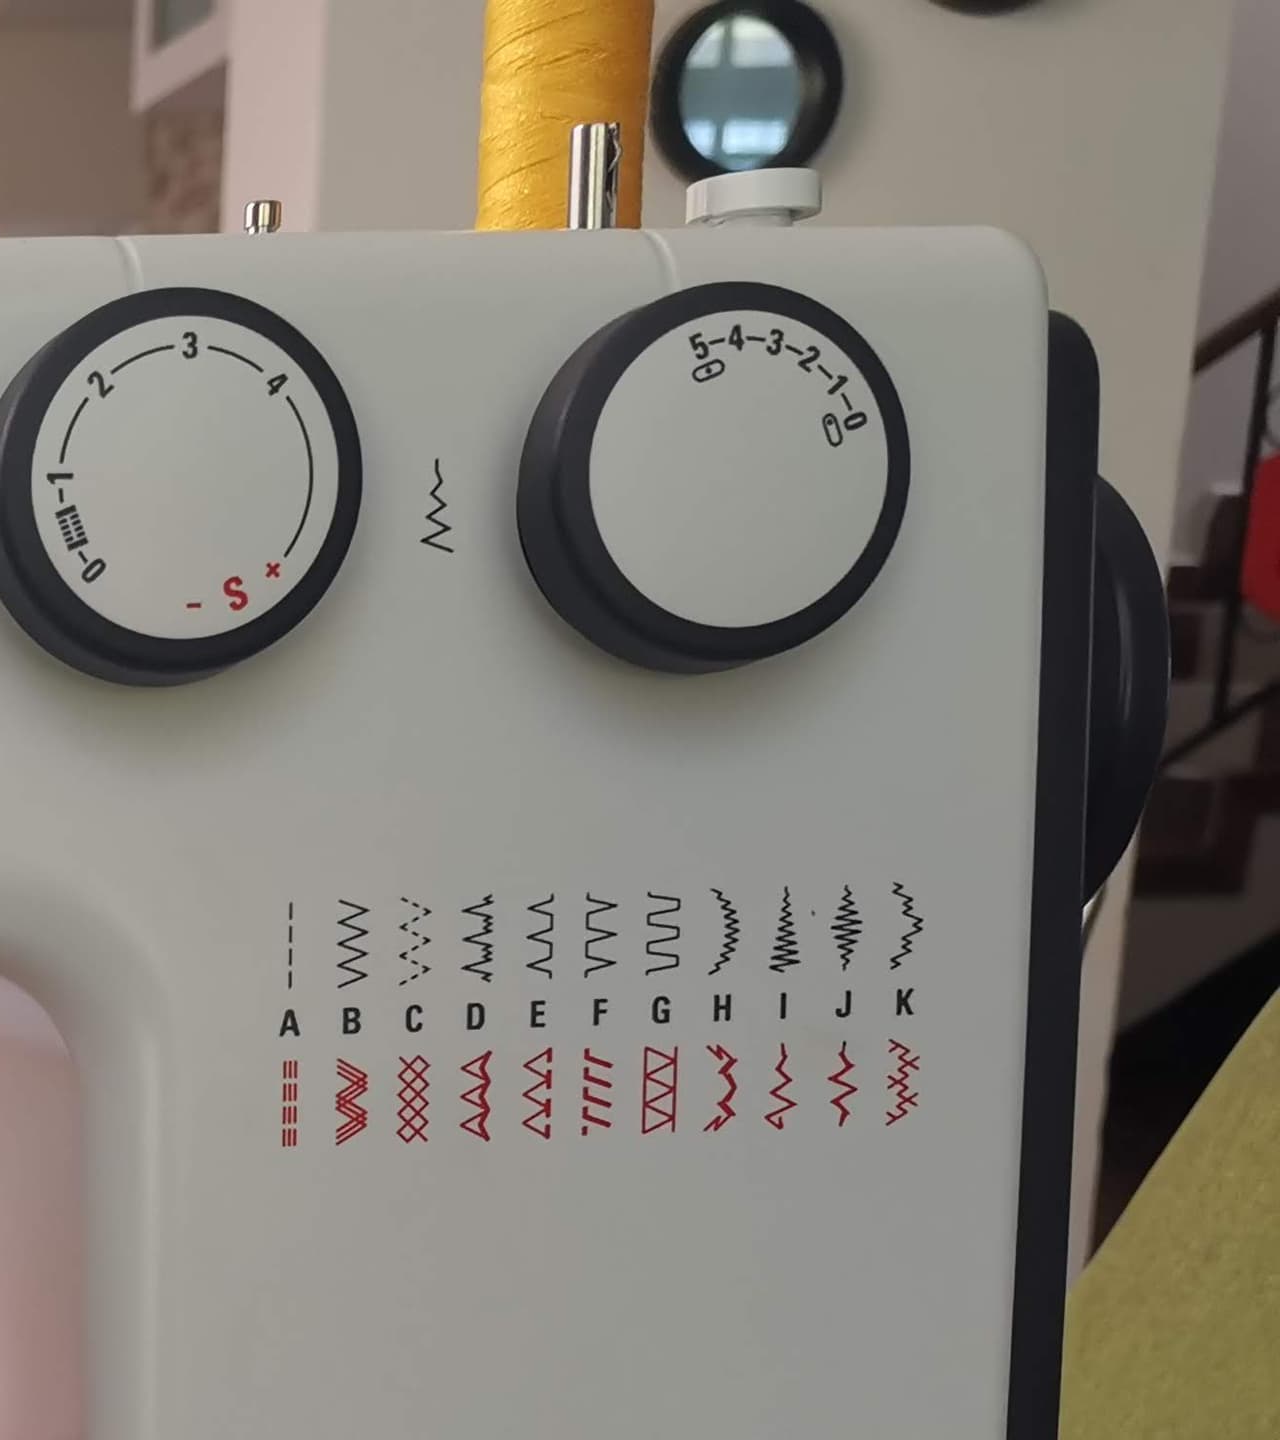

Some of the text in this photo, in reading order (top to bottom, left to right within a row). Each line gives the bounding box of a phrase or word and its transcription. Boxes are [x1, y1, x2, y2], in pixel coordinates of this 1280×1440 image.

[181, 331, 199, 360] 3
[87, 370, 115, 399] 2
[266, 372, 289, 396] 4
[46, 472, 75, 486] 1
[81, 557, 107, 584] 0
[223, 576, 249, 612] S
[278, 987, 915, 1038] A B C D E F G H I J K
